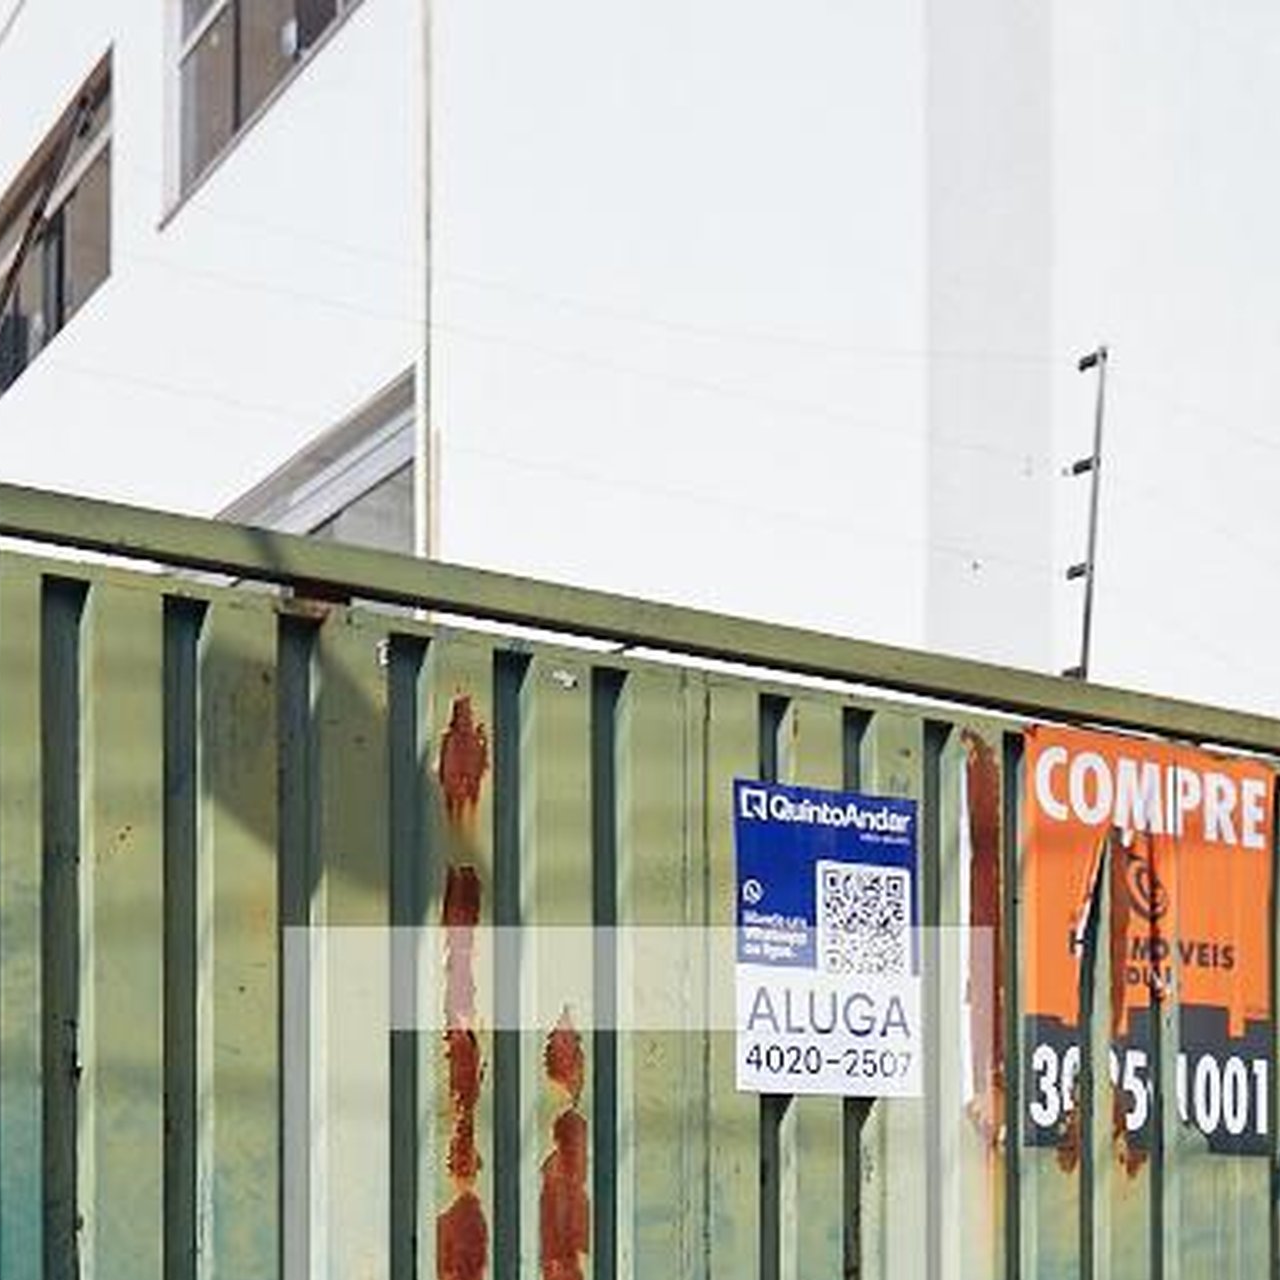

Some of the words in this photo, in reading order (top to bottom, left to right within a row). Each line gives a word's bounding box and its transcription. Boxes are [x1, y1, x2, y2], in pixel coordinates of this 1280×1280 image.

[770, 794, 911, 832] QuintoAndar
[1035, 746, 1267, 849] COMPRE
[747, 986, 911, 1038] ALUGA
[746, 1043, 911, 1078] 4020-2507
